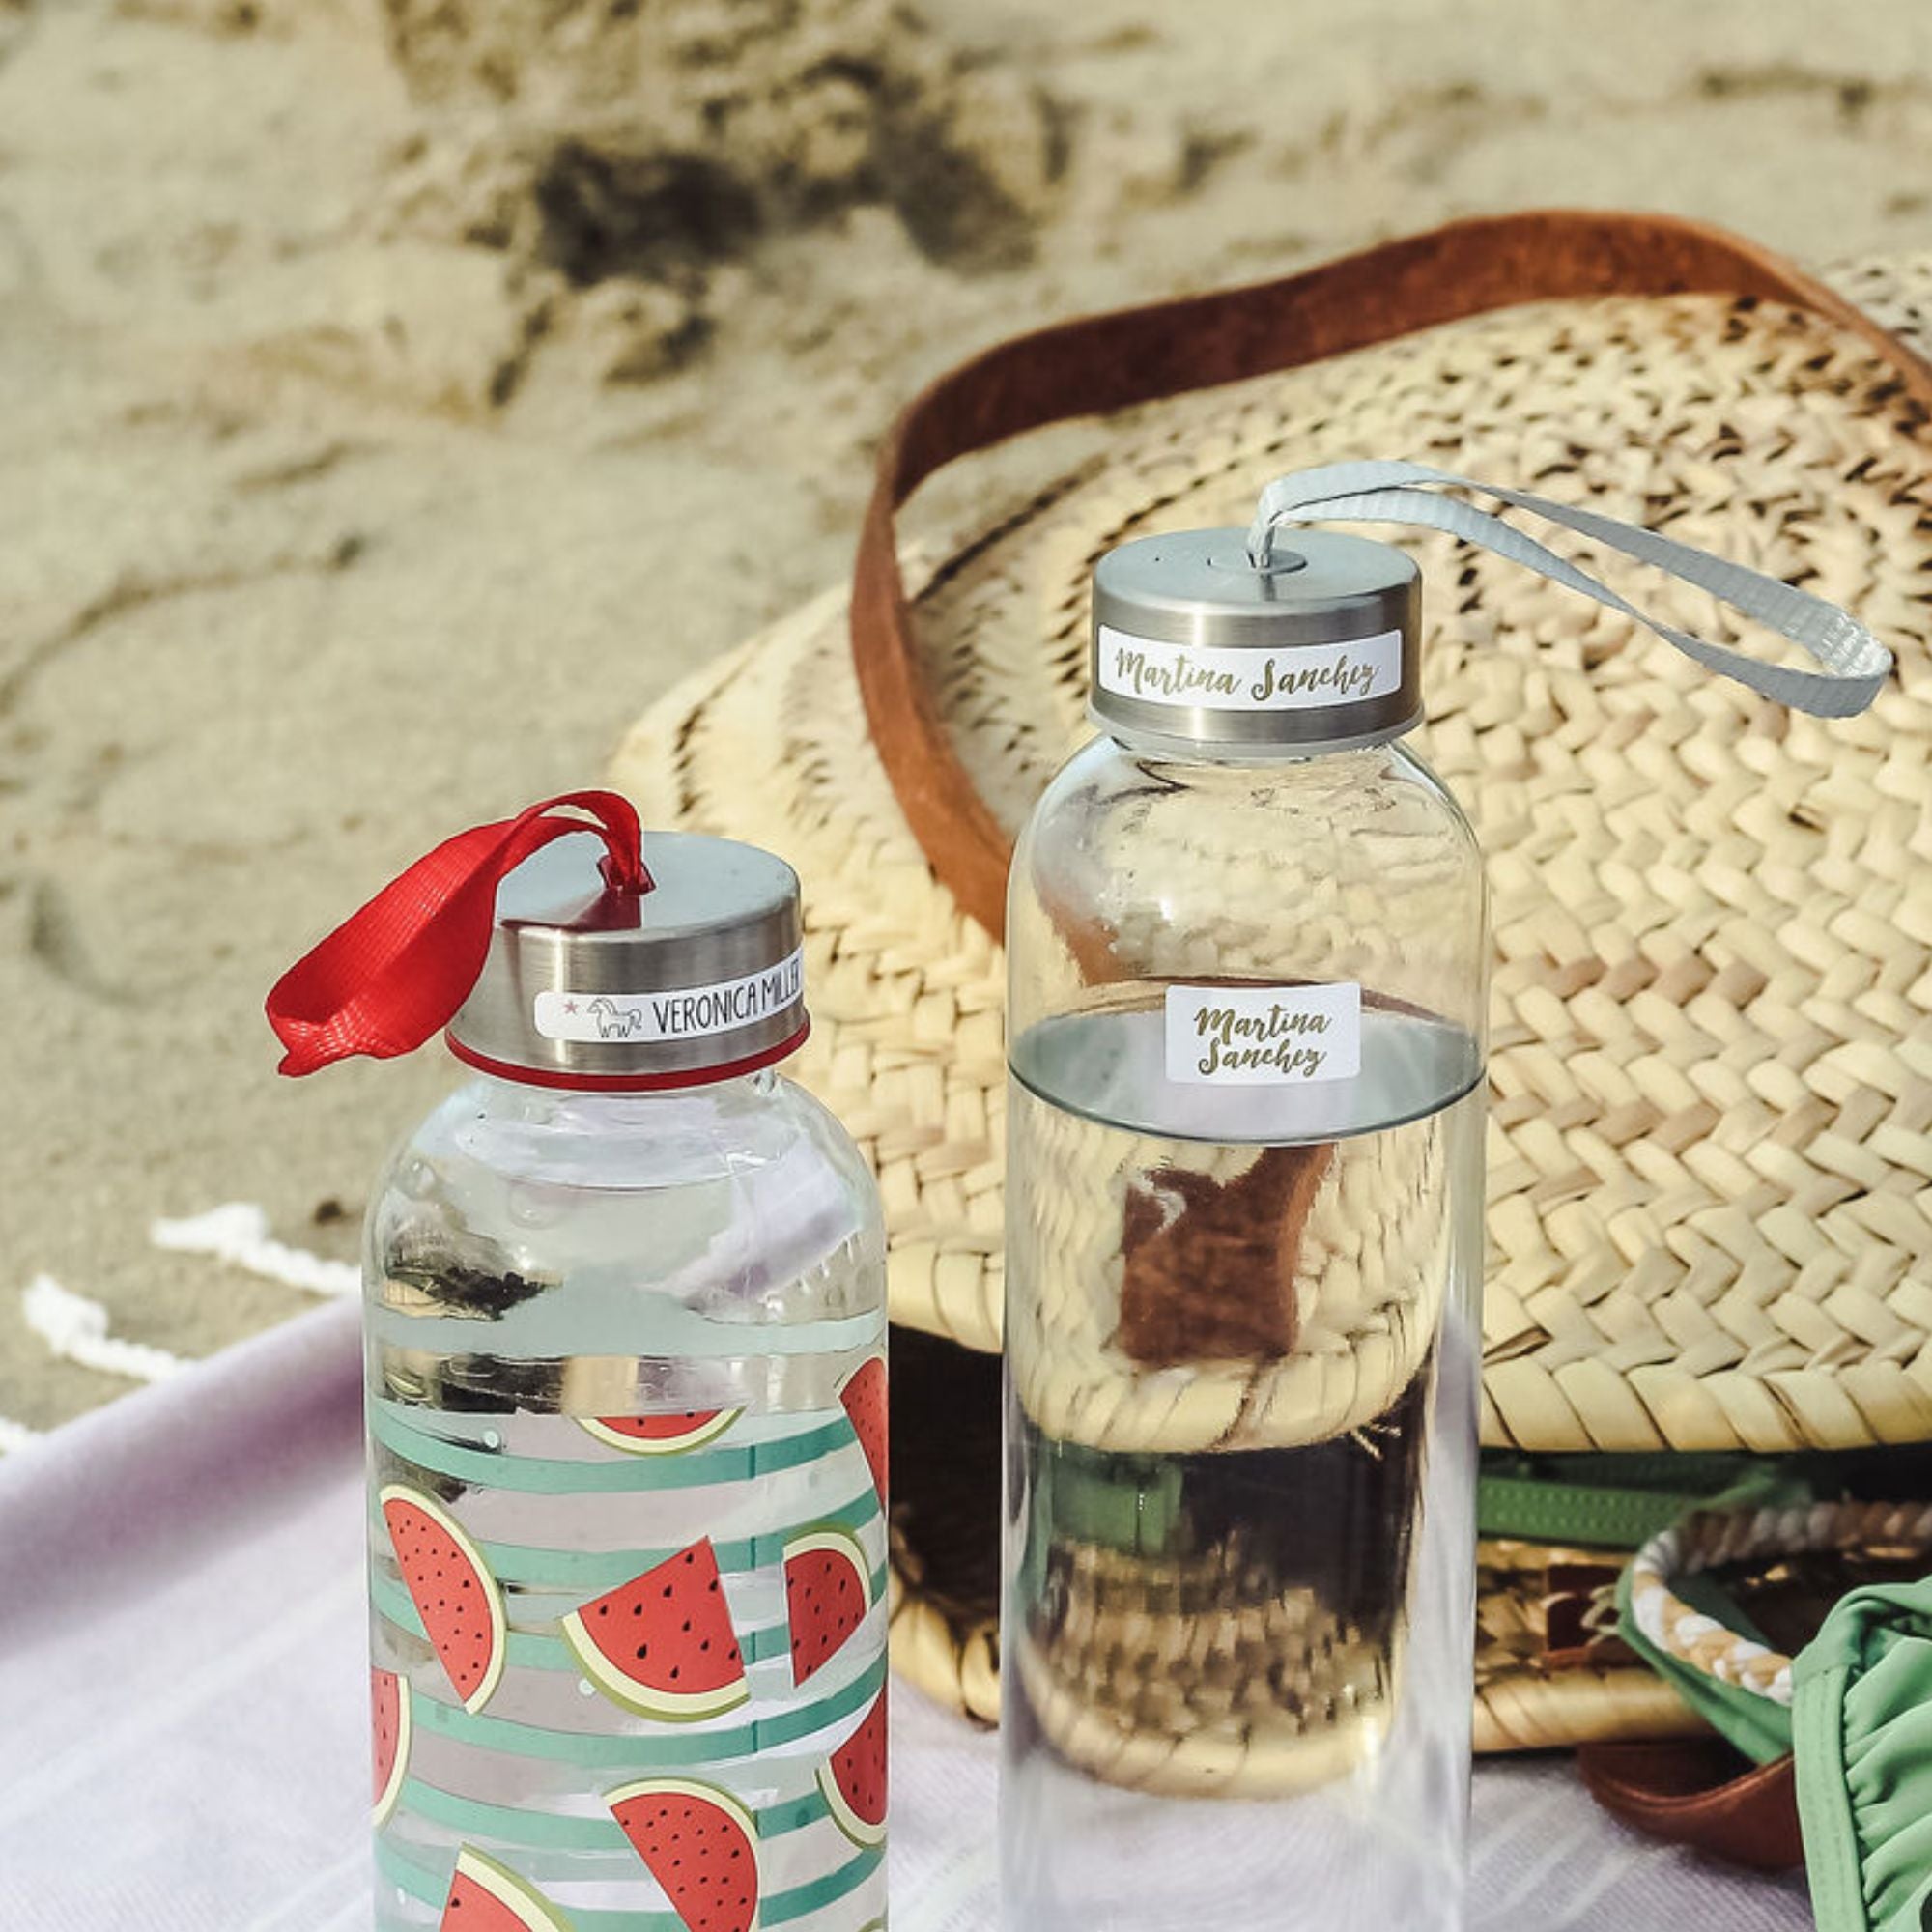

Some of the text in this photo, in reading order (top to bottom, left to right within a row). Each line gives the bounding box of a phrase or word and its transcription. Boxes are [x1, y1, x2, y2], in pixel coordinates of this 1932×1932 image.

[1115, 648, 1379, 700] Martina Sanchez
[652, 982, 756, 1034] VERONICA
[1194, 1004, 1332, 1045] Martina
[1198, 1037, 1327, 1077] Sanchez
